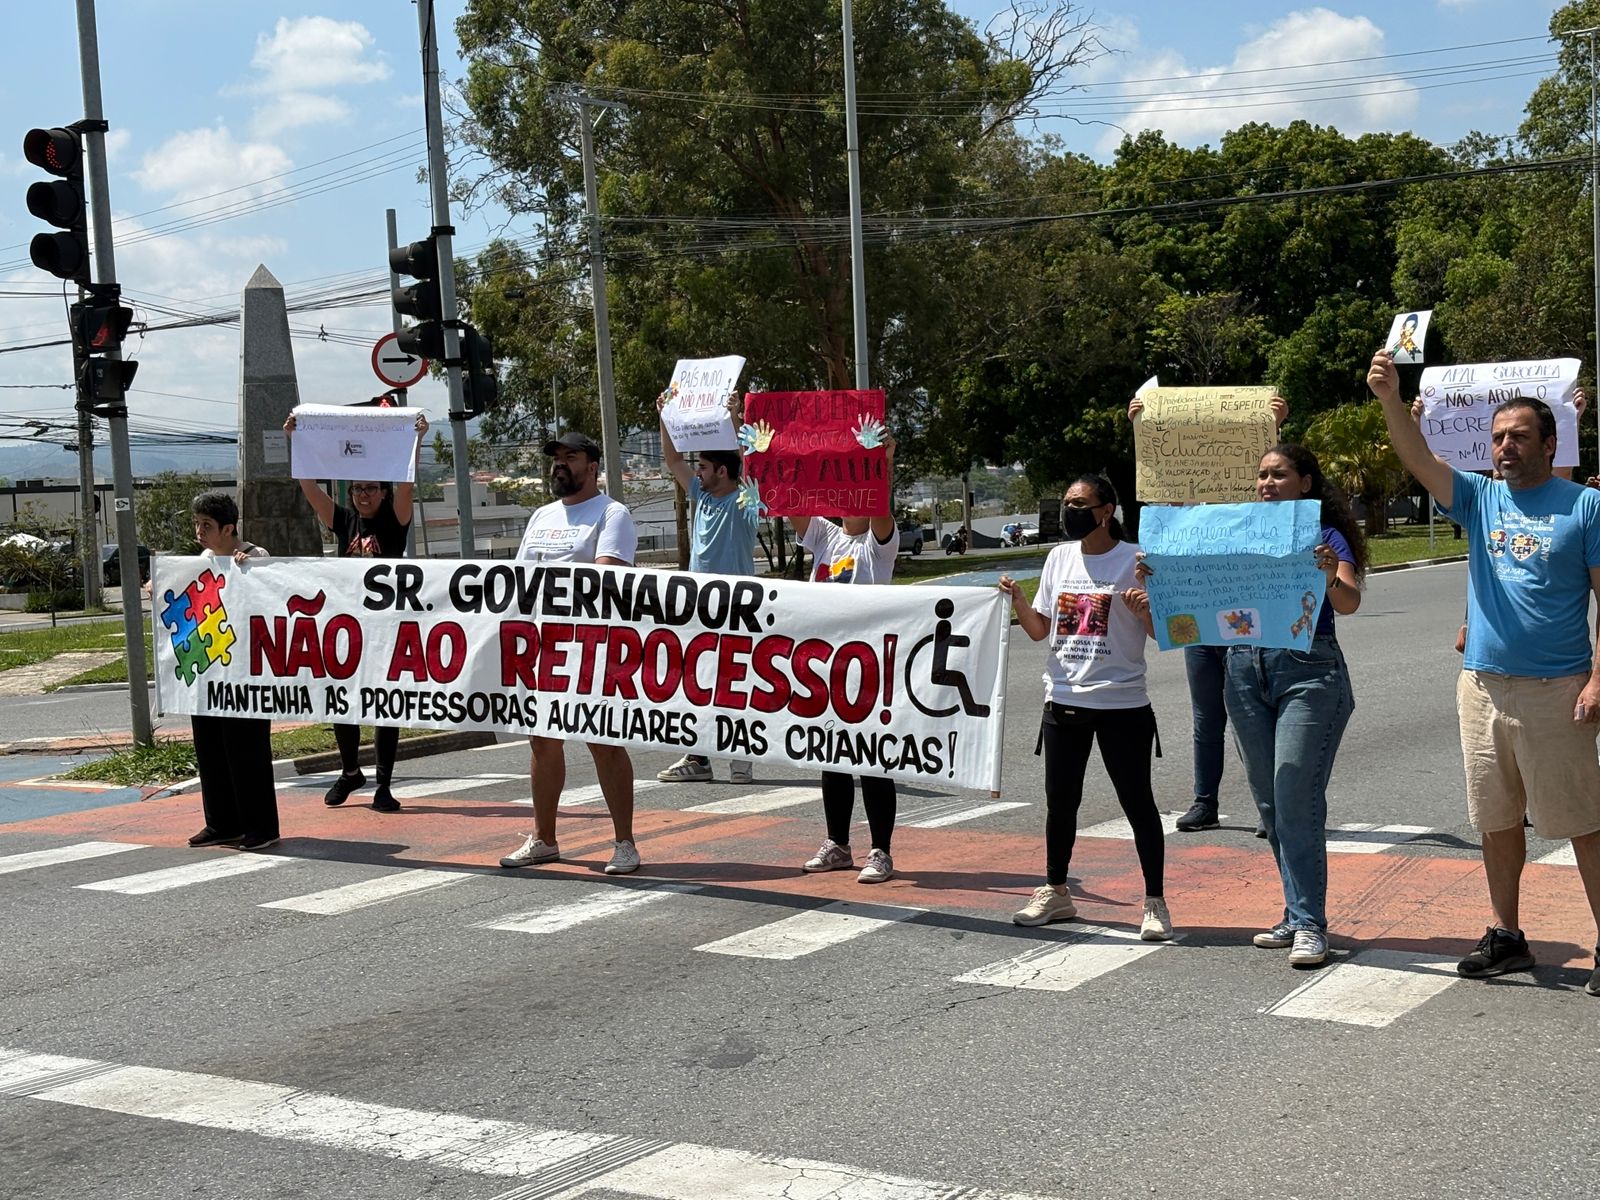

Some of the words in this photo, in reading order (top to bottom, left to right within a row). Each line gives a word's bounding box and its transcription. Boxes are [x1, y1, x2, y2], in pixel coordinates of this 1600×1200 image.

[680, 366, 700, 388] PAÍS
[700, 369, 723, 387] MUDO
[679, 390, 696, 409] NÃO
[1220, 399, 1266, 413] RESPEITO
[1445, 388, 1474, 408] NÃO
[1488, 387, 1522, 405] APOIA
[1536, 385, 1547, 399] O
[1427, 416, 1489, 436] DECRE
[1155, 515, 1235, 546] Ninguém
[1241, 515, 1282, 546] fala
[363, 564, 433, 611] SR.
[449, 564, 777, 633] GOVERNADOR:
[249, 589, 363, 680] NÃO
[386, 621, 468, 684] AO
[500, 620, 898, 726] RETROCESSO!
[207, 680, 313, 715] MANTENHA
[325, 685, 349, 716] AS
[360, 687, 537, 729] PROFESSORAS
[547, 699, 698, 747] AUXILIARES
[715, 715, 769, 757] DAS
[785, 719, 958, 779] CRIANÇAS!
